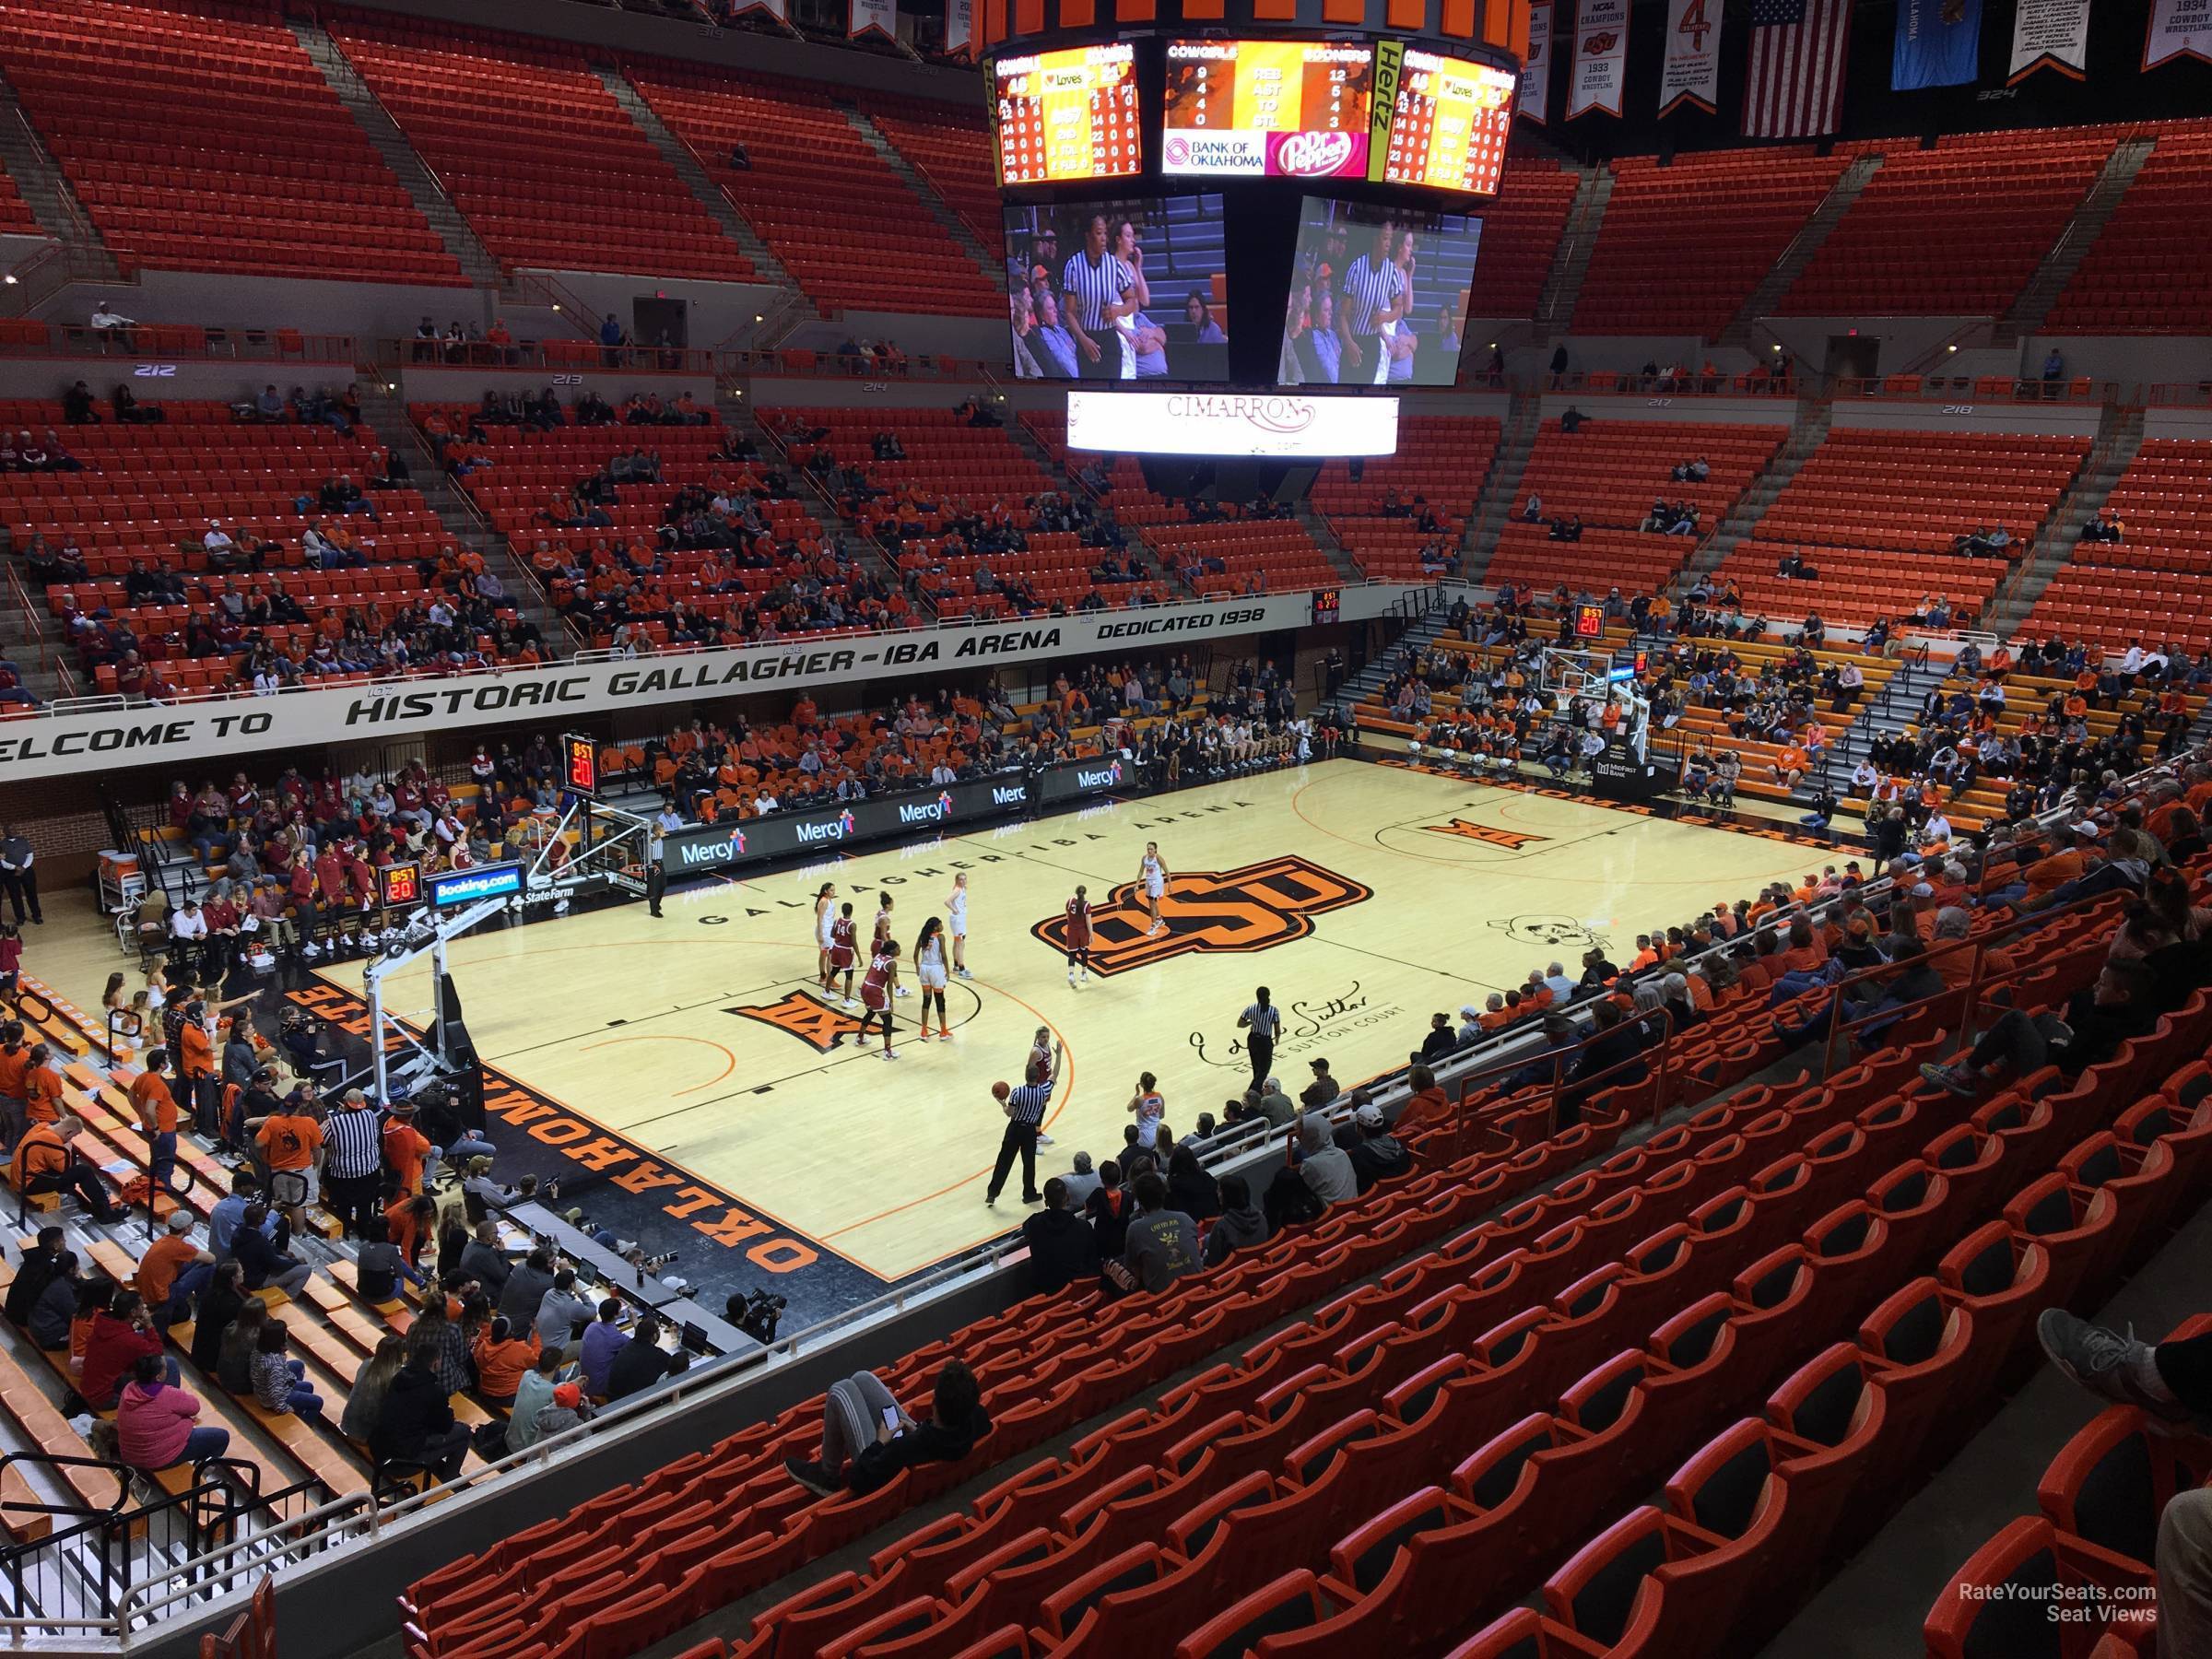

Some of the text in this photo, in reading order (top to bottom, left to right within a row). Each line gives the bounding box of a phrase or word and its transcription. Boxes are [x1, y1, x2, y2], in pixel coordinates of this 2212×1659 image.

[2177, 0, 2207, 11] 1934
[1581, 12, 1624, 24] CHAMPIONS
[2170, 14, 2210, 24] COWBOY
[698, 27, 724, 39] 319
[2165, 24, 2212, 33] WRESTLING
[1168, 45, 1239, 59] COWGIRLS
[1302, 49, 1371, 62] SOONERS
[1197, 66, 1346, 81] 9 REB 12
[1589, 63, 1608, 73] 1933
[1584, 75, 1611, 83] COWBOY
[1122, 84, 1135, 95] PT
[1197, 83, 1341, 97] 4 AST 5
[1374, 46, 1400, 131] Hertz
[1582, 82, 1613, 90] WRESTLING
[1125, 95, 1133, 106] 0
[1977, 88, 2018, 100] 324
[1196, 99, 1340, 112] 4 TO 4
[1398, 101, 1408, 112] 12
[1002, 109, 1013, 120] 12
[1091, 112, 1133, 126] 14 0 5
[1195, 114, 1206, 125] 0
[1329, 117, 1339, 128] 3
[1003, 121, 1041, 135] 14 0 0
[1395, 118, 1406, 129] 14
[1091, 131, 1104, 142] 22
[1110, 129, 1118, 140] 0
[1309, 132, 1329, 147] Dr
[1393, 135, 1403, 145] 15
[1004, 136, 1042, 150] 15 0 0
[1193, 141, 1249, 154] BANK OF
[1093, 144, 1135, 158] 30 0 0
[1284, 137, 1347, 171] Pepper
[1390, 151, 1401, 161] 23
[1005, 153, 1029, 166] 23 0
[1191, 155, 1264, 168] OKLAHOMA
[1094, 163, 1106, 174] 32
[1128, 160, 1135, 171] 2
[1387, 168, 1398, 179] 30
[1006, 168, 1044, 182] 30 0 0
[135, 364, 176, 376] 212
[553, 374, 582, 385] 213
[863, 382, 888, 393] 214
[1168, 396, 1309, 422] CIMARRON
[1647, 398, 1674, 407] 217
[1942, 405, 1974, 415] 218
[1584, 607, 1602, 618] 8:57
[1097, 614, 1215, 640] DEDICATED
[1219, 607, 1266, 626] 1938
[1580, 618, 1599, 634] 20
[346, 677, 591, 725] HISTORIC
[955, 628, 1062, 658] ARENA
[368, 686, 397, 698] 107
[211, 712, 273, 737] TO
[573, 742, 592, 759] 8:57
[572, 759, 592, 786] 20
[1078, 770, 1113, 788] Mercy
[1610, 770, 1626, 778] BANK
[994, 787, 1026, 805] Merc
[900, 803, 942, 823] Mercy
[1133, 800, 1255, 830] ARENA
[796, 821, 843, 843] Mercy
[682, 840, 735, 865] Mercy
[390, 868, 415, 882] 8:57
[389, 882, 411, 900] 20
[438, 872, 517, 898] Booking.com
[1030, 854, 1375, 979] OSU
[837, 924, 846, 936] 14
[873, 956, 884, 971] 24
[1289, 1029, 1352, 1053] SUTTON
[1354, 1006, 1406, 1028] COURT
